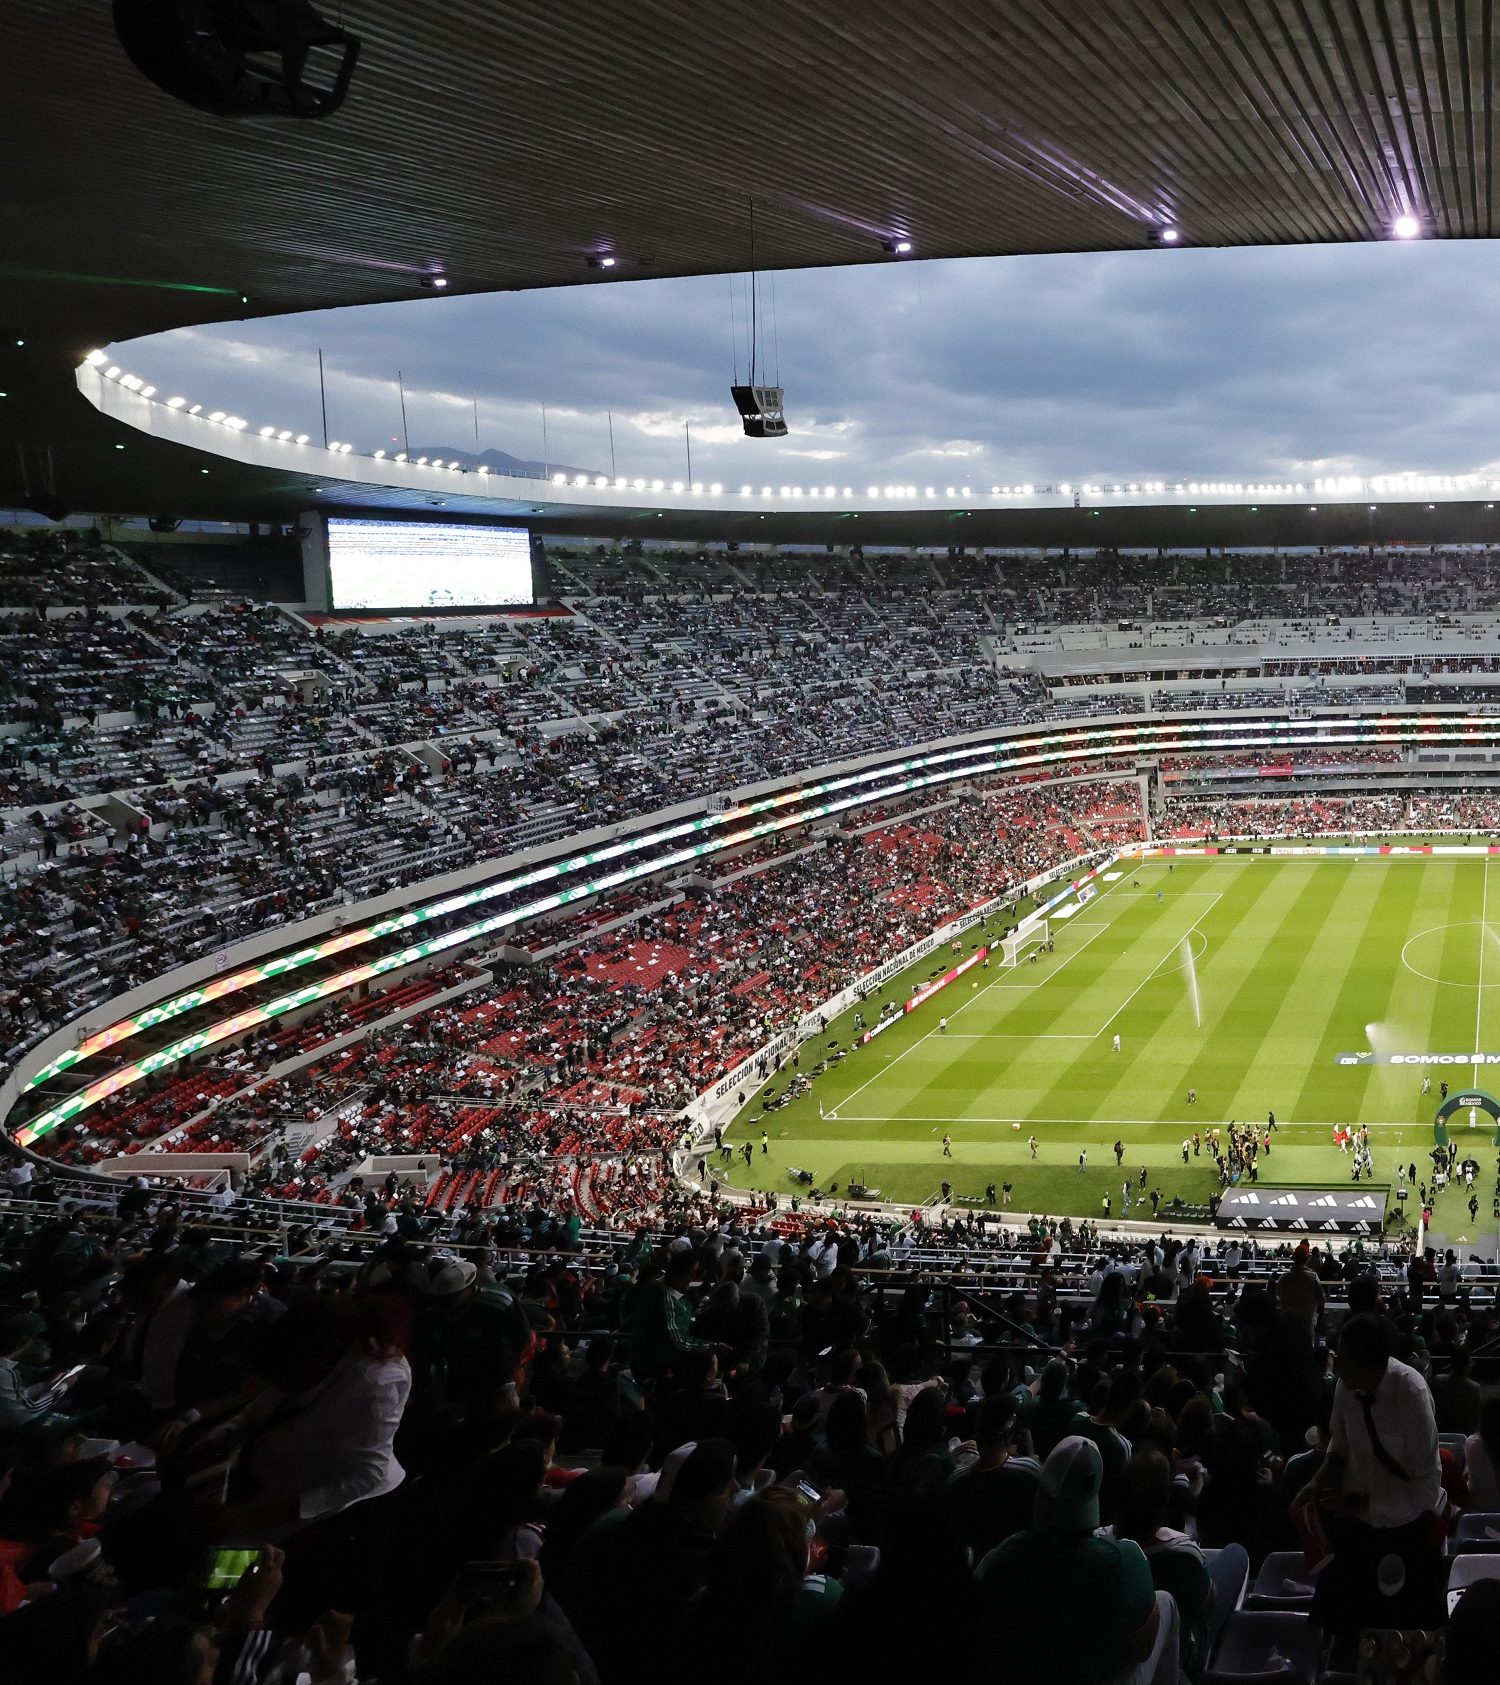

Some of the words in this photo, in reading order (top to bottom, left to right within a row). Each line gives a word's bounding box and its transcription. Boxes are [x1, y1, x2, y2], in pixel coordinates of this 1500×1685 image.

[853, 972, 882, 997] SELECCIÓN
[882, 957, 909, 977] NACIONAL
[909, 949, 916, 960] DE
[916, 937, 935, 954] MÉXICO
[716, 1061, 753, 1100] SELECCIÓN
[754, 1035, 789, 1067] NACIONAL
[1390, 1055, 1469, 1064] SOMOS
